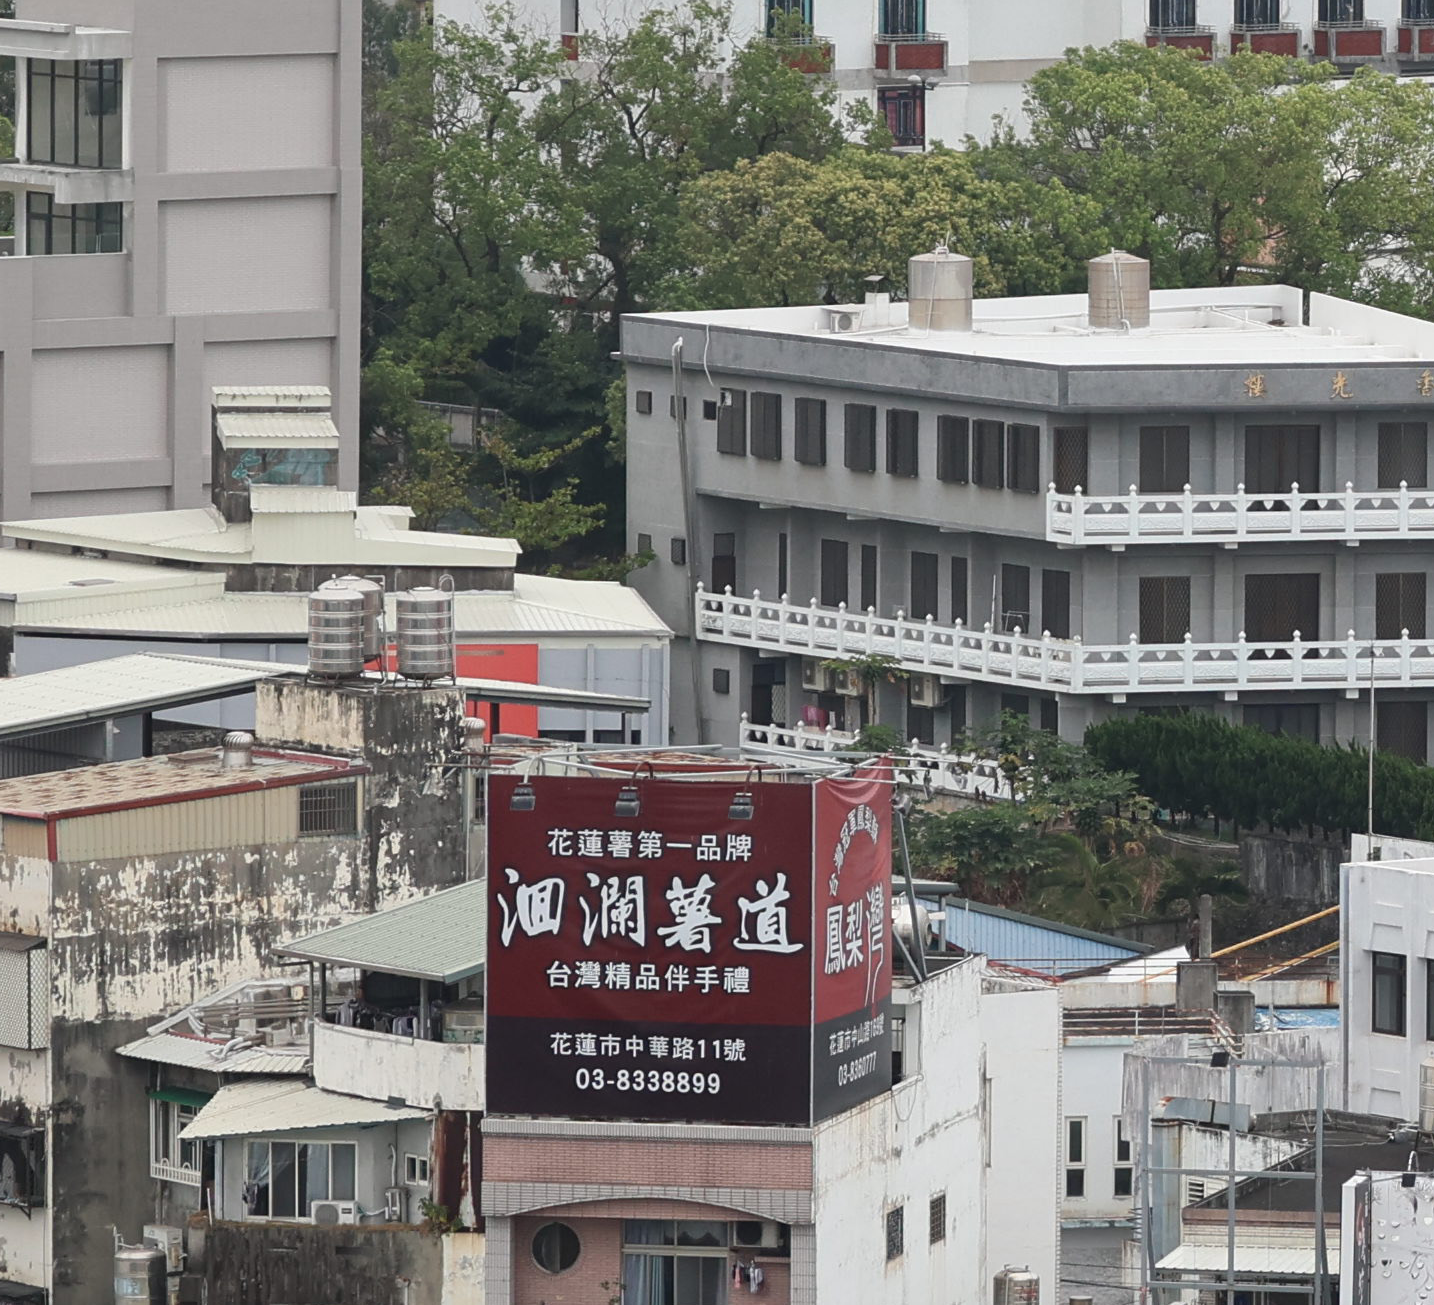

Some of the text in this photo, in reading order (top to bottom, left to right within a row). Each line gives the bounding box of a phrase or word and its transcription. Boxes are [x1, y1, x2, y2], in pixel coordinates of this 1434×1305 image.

[548, 828, 752, 862] 花蓮薯第一品牌
[498, 868, 804, 954] 洄瀾薯道
[546, 960, 750, 995] 台灣精品伴手禮
[549, 1032, 747, 1062] 花蓮市中華路11號
[575, 1068, 721, 1095] 03-8338899
[837, 1051, 878, 1087] 03-8360777
